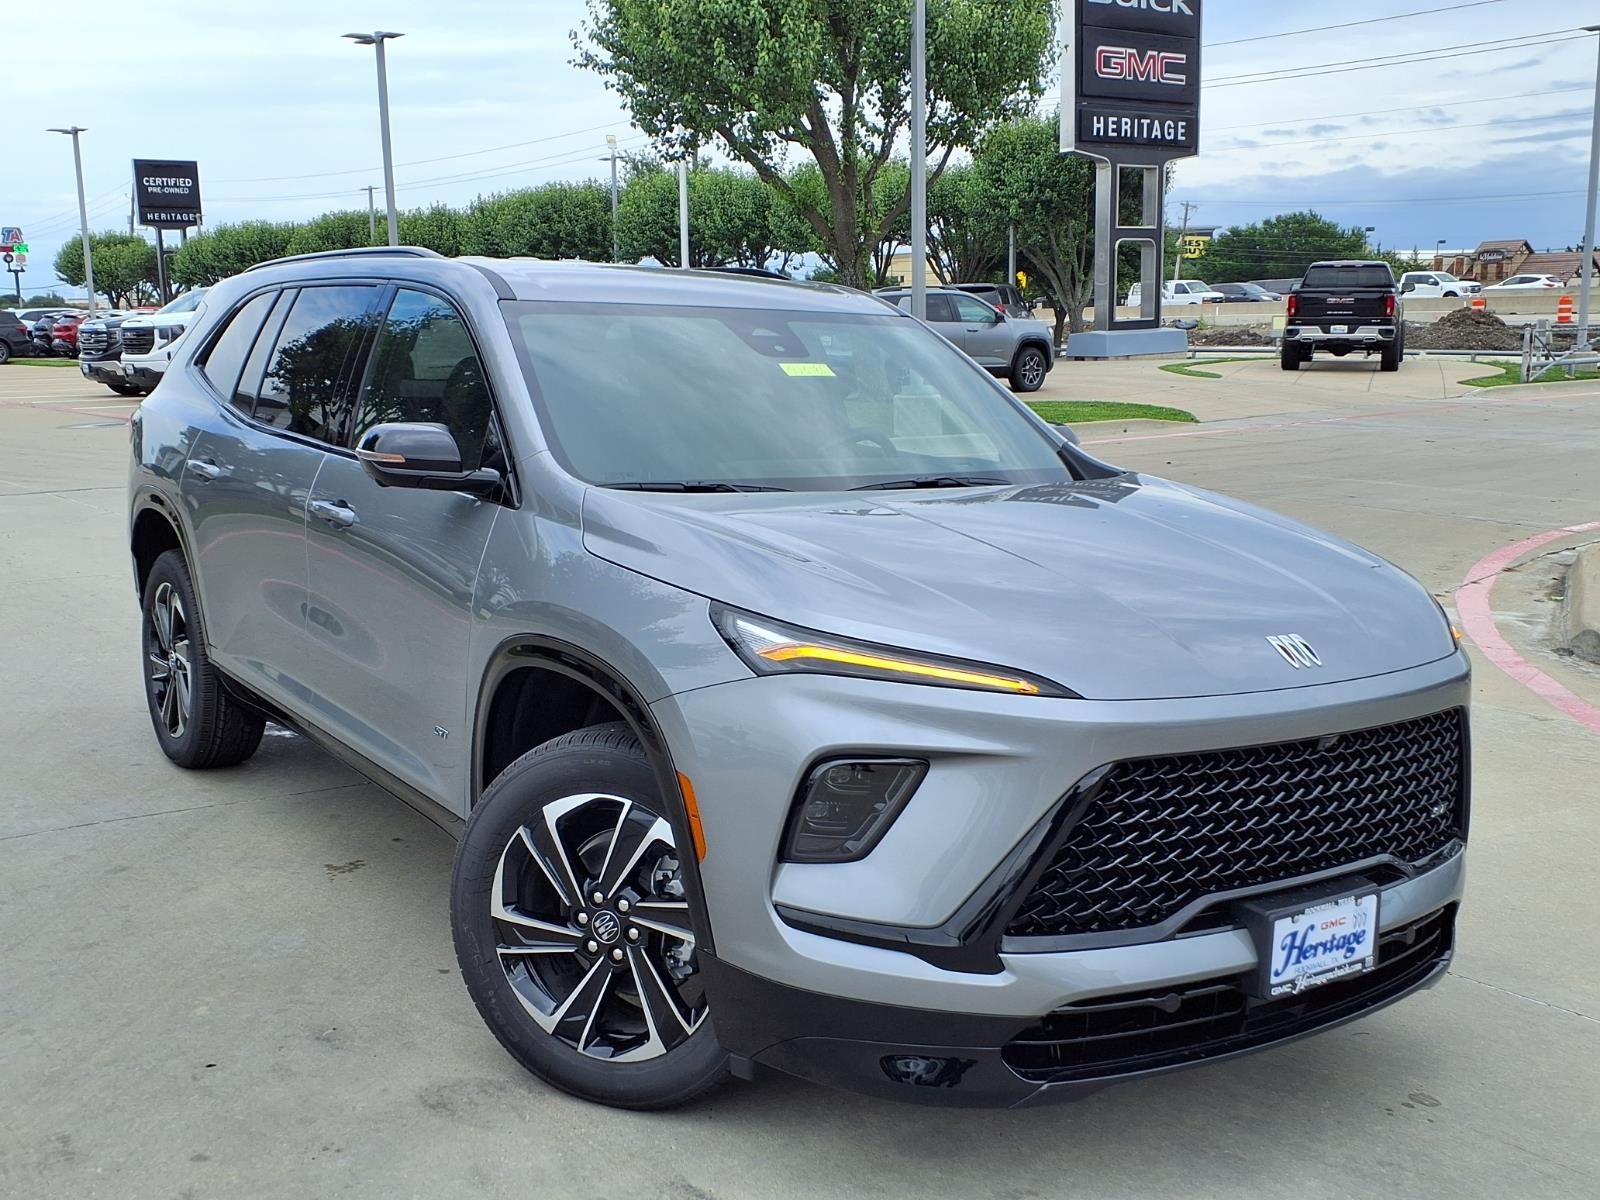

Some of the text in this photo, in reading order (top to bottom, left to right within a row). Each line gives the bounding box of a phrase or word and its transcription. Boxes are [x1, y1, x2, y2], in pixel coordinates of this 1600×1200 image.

[1096, 45, 1187, 85] GMC
[1093, 115, 1187, 141] HERITAGE
[143, 177, 193, 187] CERTIFIED
[147, 186, 190, 194] PRE-OWNED
[147, 212, 195, 221] HERITAGE
[1320, 917, 1346, 930] GMC
[1273, 923, 1366, 978] Heritage
